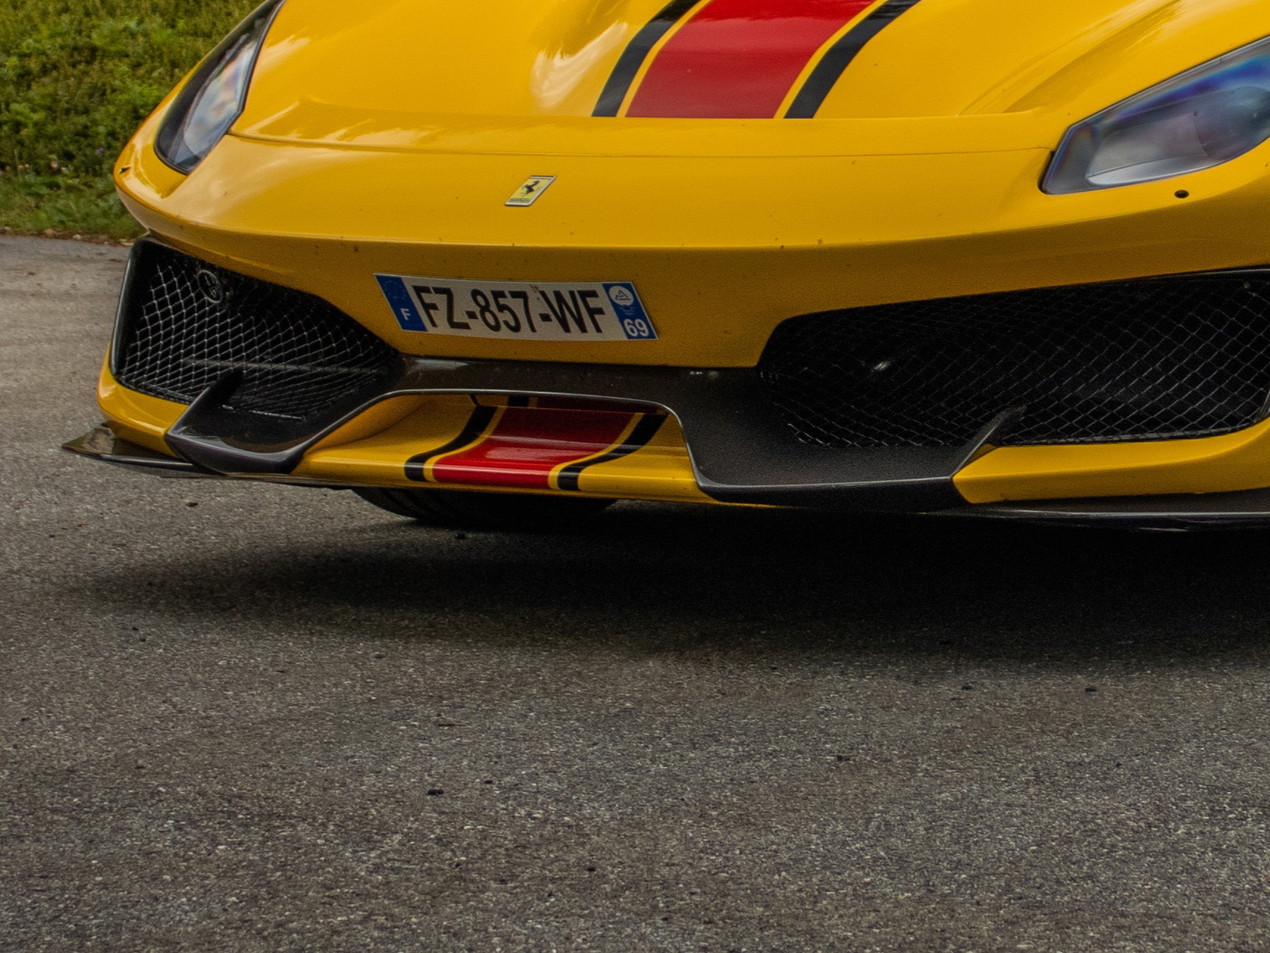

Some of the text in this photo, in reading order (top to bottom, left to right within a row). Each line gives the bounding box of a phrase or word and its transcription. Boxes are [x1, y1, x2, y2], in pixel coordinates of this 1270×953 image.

[400, 308, 411, 321] F
[411, 284, 605, 334] FZ-857-WF
[623, 318, 649, 338] 69
